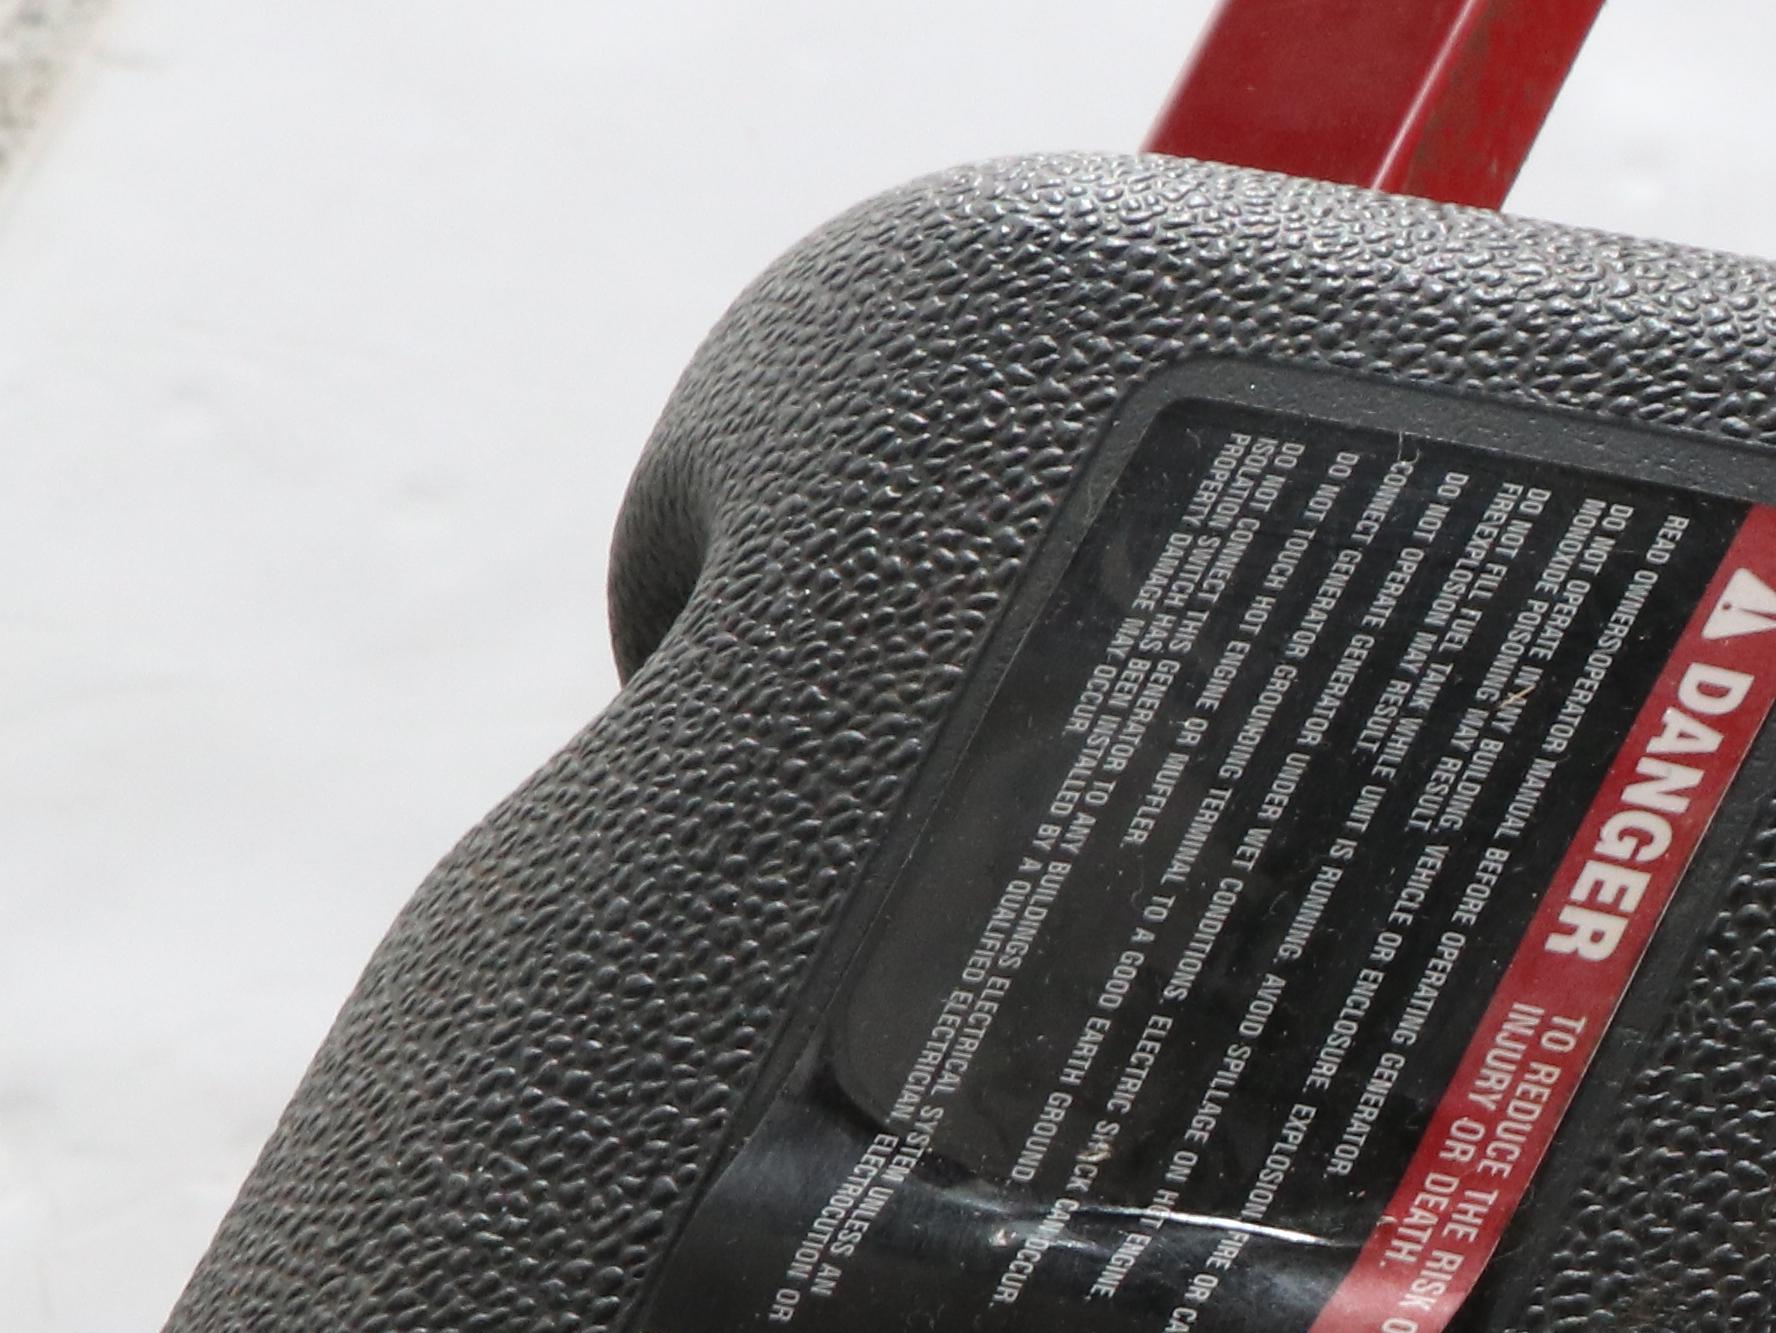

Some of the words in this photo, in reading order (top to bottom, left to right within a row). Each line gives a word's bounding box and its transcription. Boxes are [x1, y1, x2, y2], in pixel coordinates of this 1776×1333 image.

[1327, 451, 1359, 478] DO
[1303, 483, 1340, 522] NOT
[1350, 461, 1413, 544] CONNECT
[1263, 528, 1316, 589] TOUCH
[1238, 595, 1276, 635] HOT
[1284, 548, 1362, 658] GENERATOR
[1195, 640, 1251, 710] ENGINE
[1175, 716, 1208, 745] OR
[1218, 664, 1297, 779] GROUNDING
[1119, 752, 1189, 847] MUFFLER.
[1544, 661, 1754, 961] DANGER
[1159, 788, 1232, 884] TERMINAL
[1130, 926, 1155, 942] A
[1142, 895, 1176, 921] TO
[1097, 950, 1145, 1008] GOOD
[1059, 1016, 1111, 1084] EARTH
[1467, 1002, 1545, 1111] INJURY
[1540, 1015, 1587, 1053] TO
[1005, 1091, 1072, 1184] GROUND.
[1438, 1116, 1485, 1162] OR
[1476, 1061, 1561, 1178] REDUCE
[1378, 1172, 1459, 1274] DEATH.
[1441, 1189, 1499, 1242] THE
[1393, 1249, 1464, 1314] RISK
